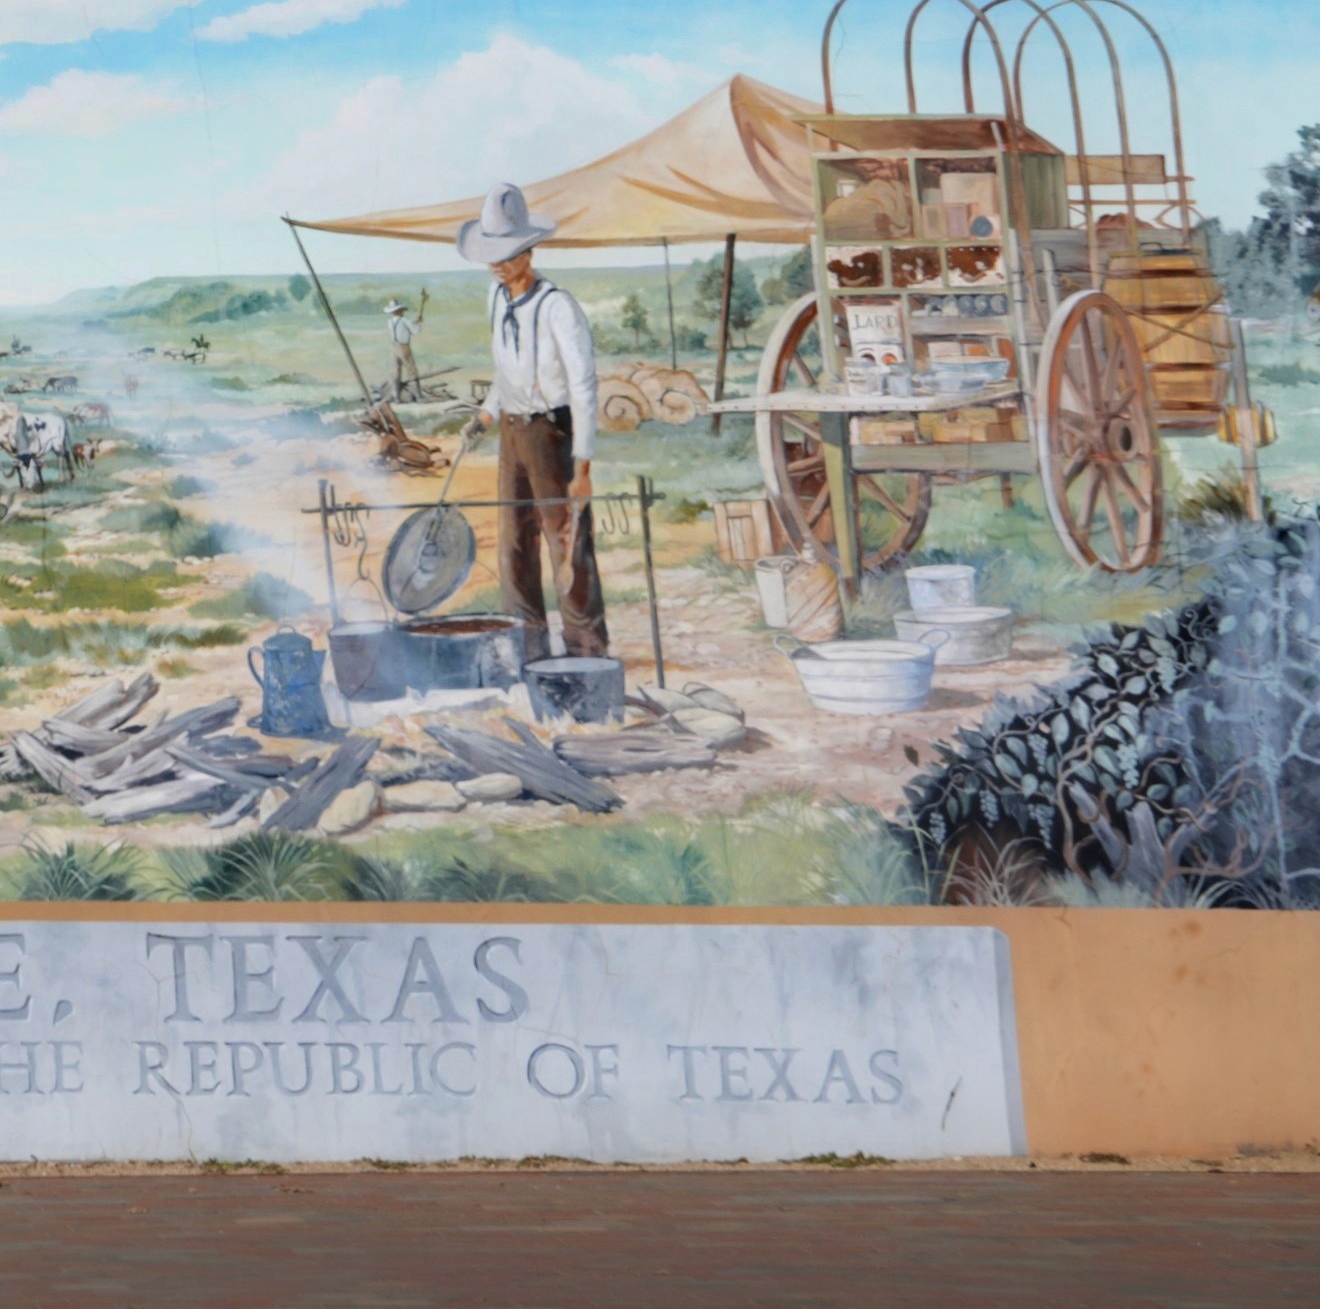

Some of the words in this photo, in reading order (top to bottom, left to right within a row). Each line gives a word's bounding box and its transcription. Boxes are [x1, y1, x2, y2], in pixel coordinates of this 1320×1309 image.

[852, 314, 898, 330] LARD
[145, 932, 530, 1024] TEXAS
[133, 1040, 478, 1099] REPUBLIC
[526, 1042, 621, 1103] OF
[667, 1043, 906, 1105] TEXAS
